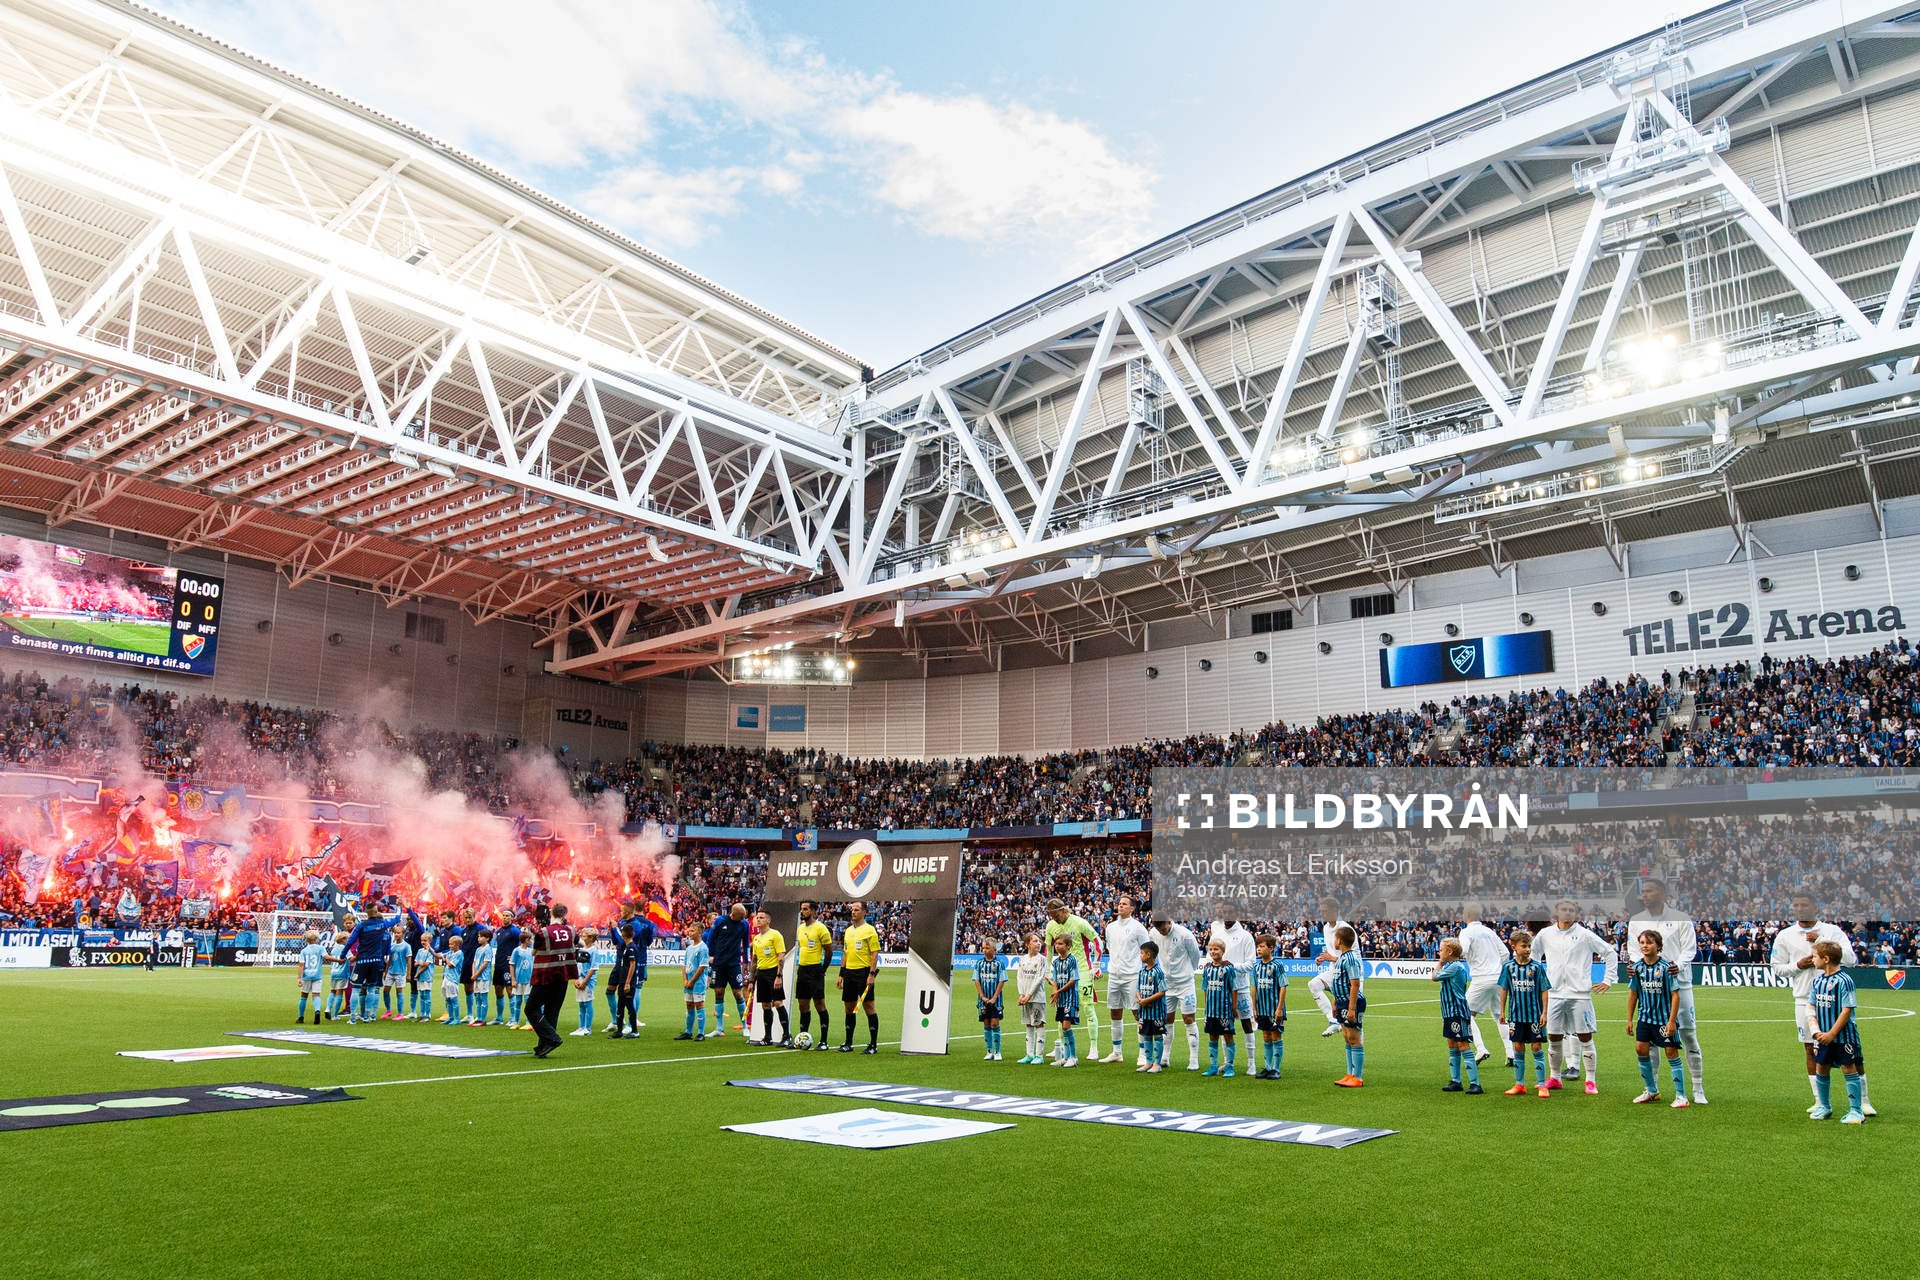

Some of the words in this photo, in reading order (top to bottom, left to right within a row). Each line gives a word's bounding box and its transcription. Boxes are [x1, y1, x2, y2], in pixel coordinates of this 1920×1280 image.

[180, 578, 219, 598] 00:00
[181, 601, 191, 616] 0
[204, 605, 214, 620] 0
[176, 620, 192, 631] DIF
[198, 623, 217, 635] MFF
[1622, 602, 1754, 656] TELE2
[1764, 605, 1907, 643] Arena
[11, 635, 58, 650] Senaste
[61, 643, 83, 655] nytt
[86, 646, 114, 659] finns
[117, 651, 144, 663] alltid
[146, 654, 160, 666] på
[162, 657, 192, 670] dif.se
[556, 709, 592, 726] TELE2
[594, 714, 628, 731] Arena
[777, 861, 829, 878] UNIBET
[892, 856, 949, 874] UNIBET
[9, 932, 40, 947] MOT
[40, 933, 79, 947] ASEN
[553, 929, 569, 942] 13
[305, 954, 318, 970] 13
[558, 953, 567, 961] TV
[1082, 984, 1093, 997] 27
[919, 990, 936, 1016] U
[806, 1084, 1360, 1143] ALLSVENSKAN
